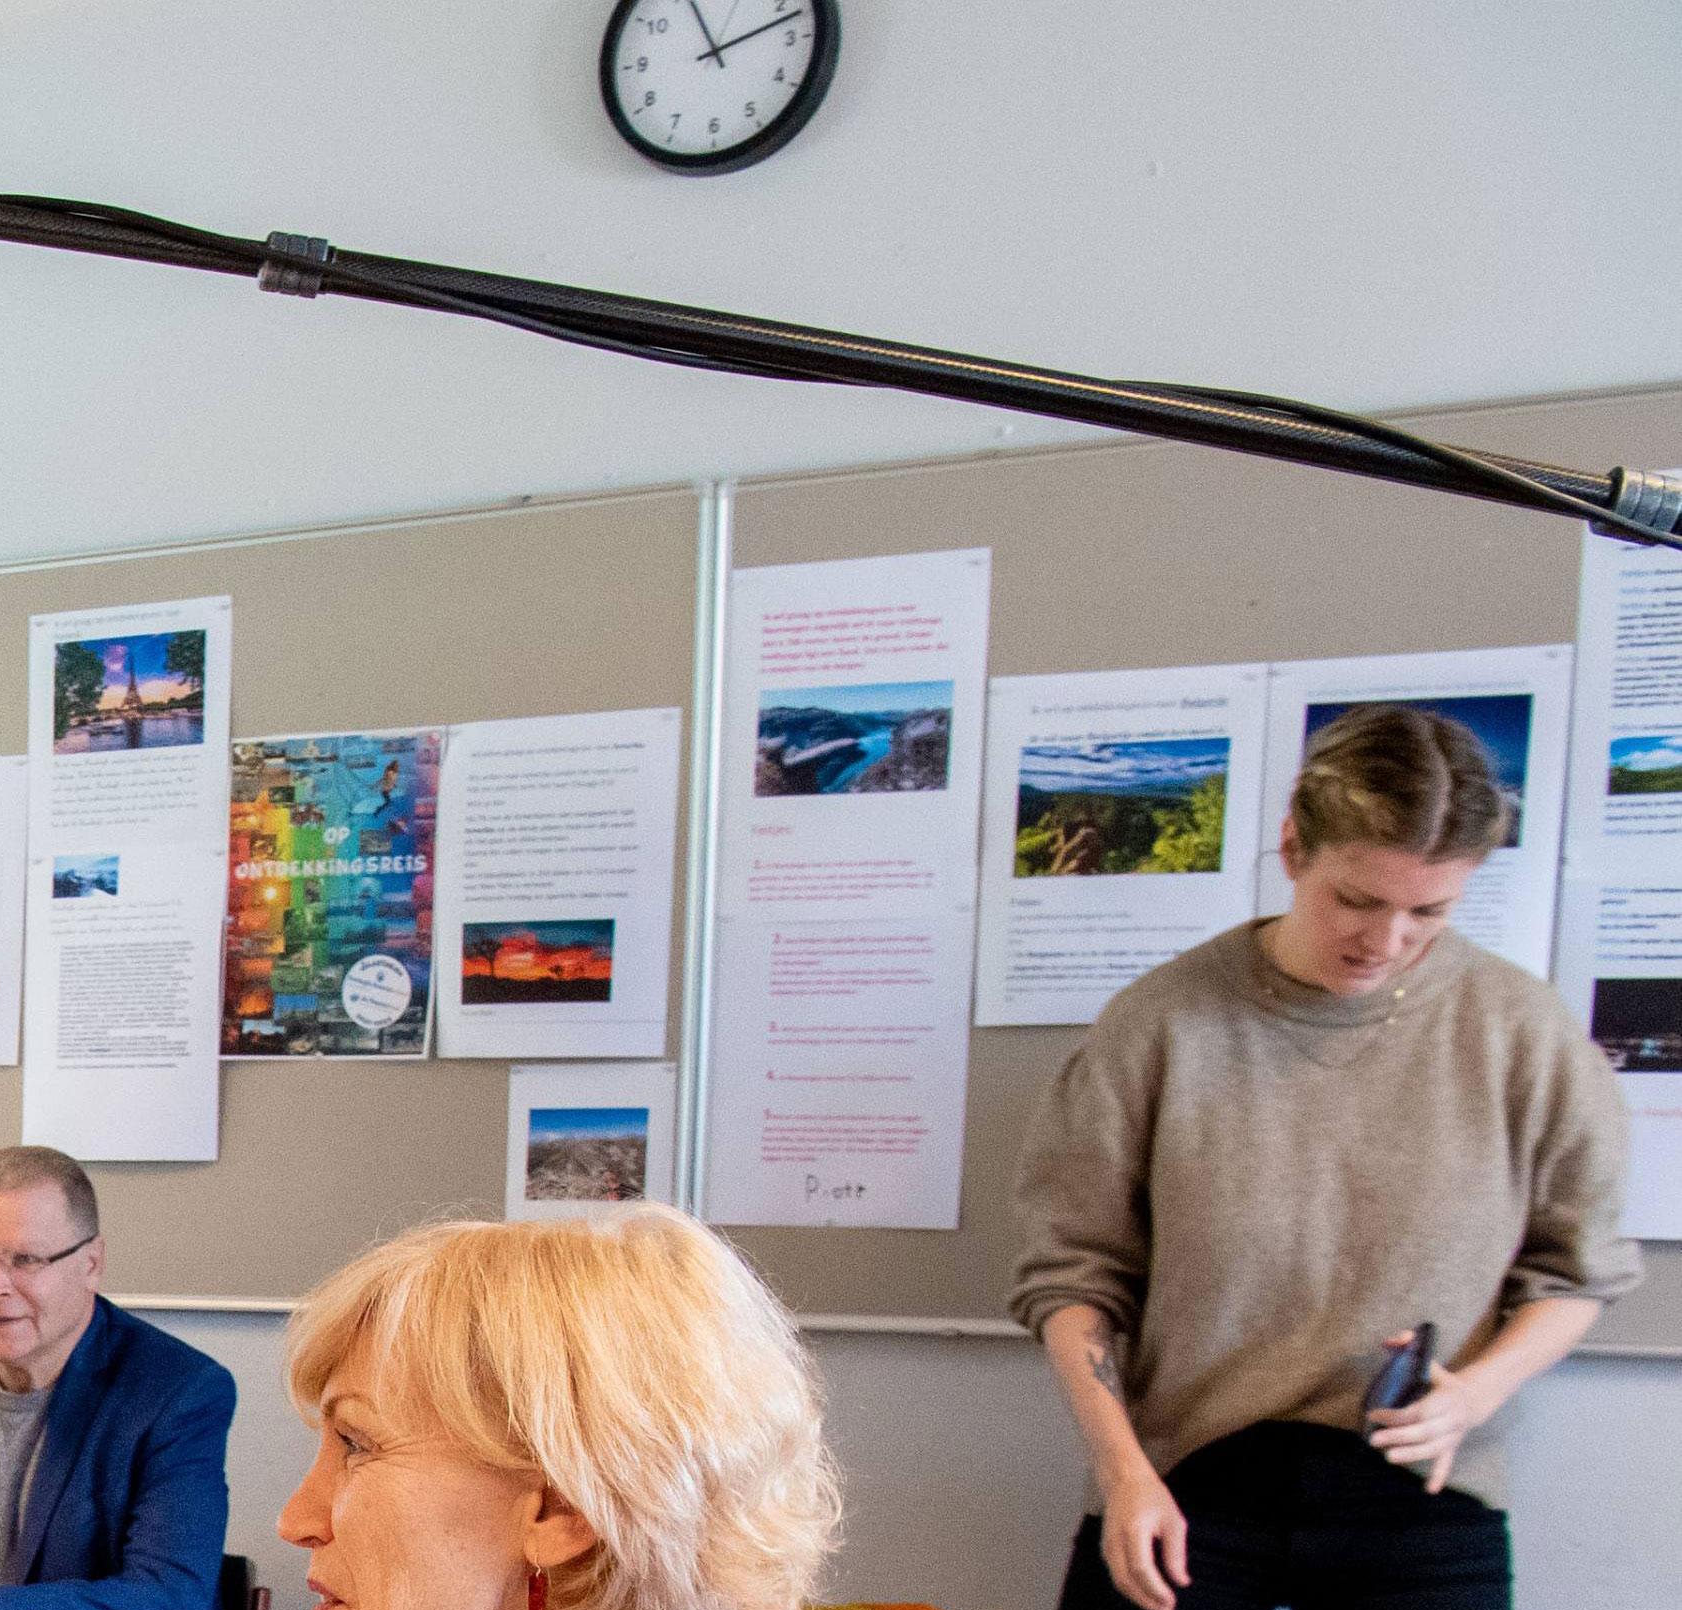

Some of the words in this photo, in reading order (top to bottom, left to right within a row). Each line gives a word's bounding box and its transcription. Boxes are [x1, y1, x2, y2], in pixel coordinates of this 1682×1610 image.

[647, 18, 669, 35] 10
[785, 30, 796, 47] 3
[637, 56, 649, 73] 9
[774, 67, 785, 82] 4
[645, 91, 656, 107] 8
[744, 101, 756, 118] 5
[670, 113, 682, 130] 7
[708, 117, 721, 134] 6
[322, 826, 352, 845] OP
[234, 854, 428, 880] ONTDEKKINGSREIS
